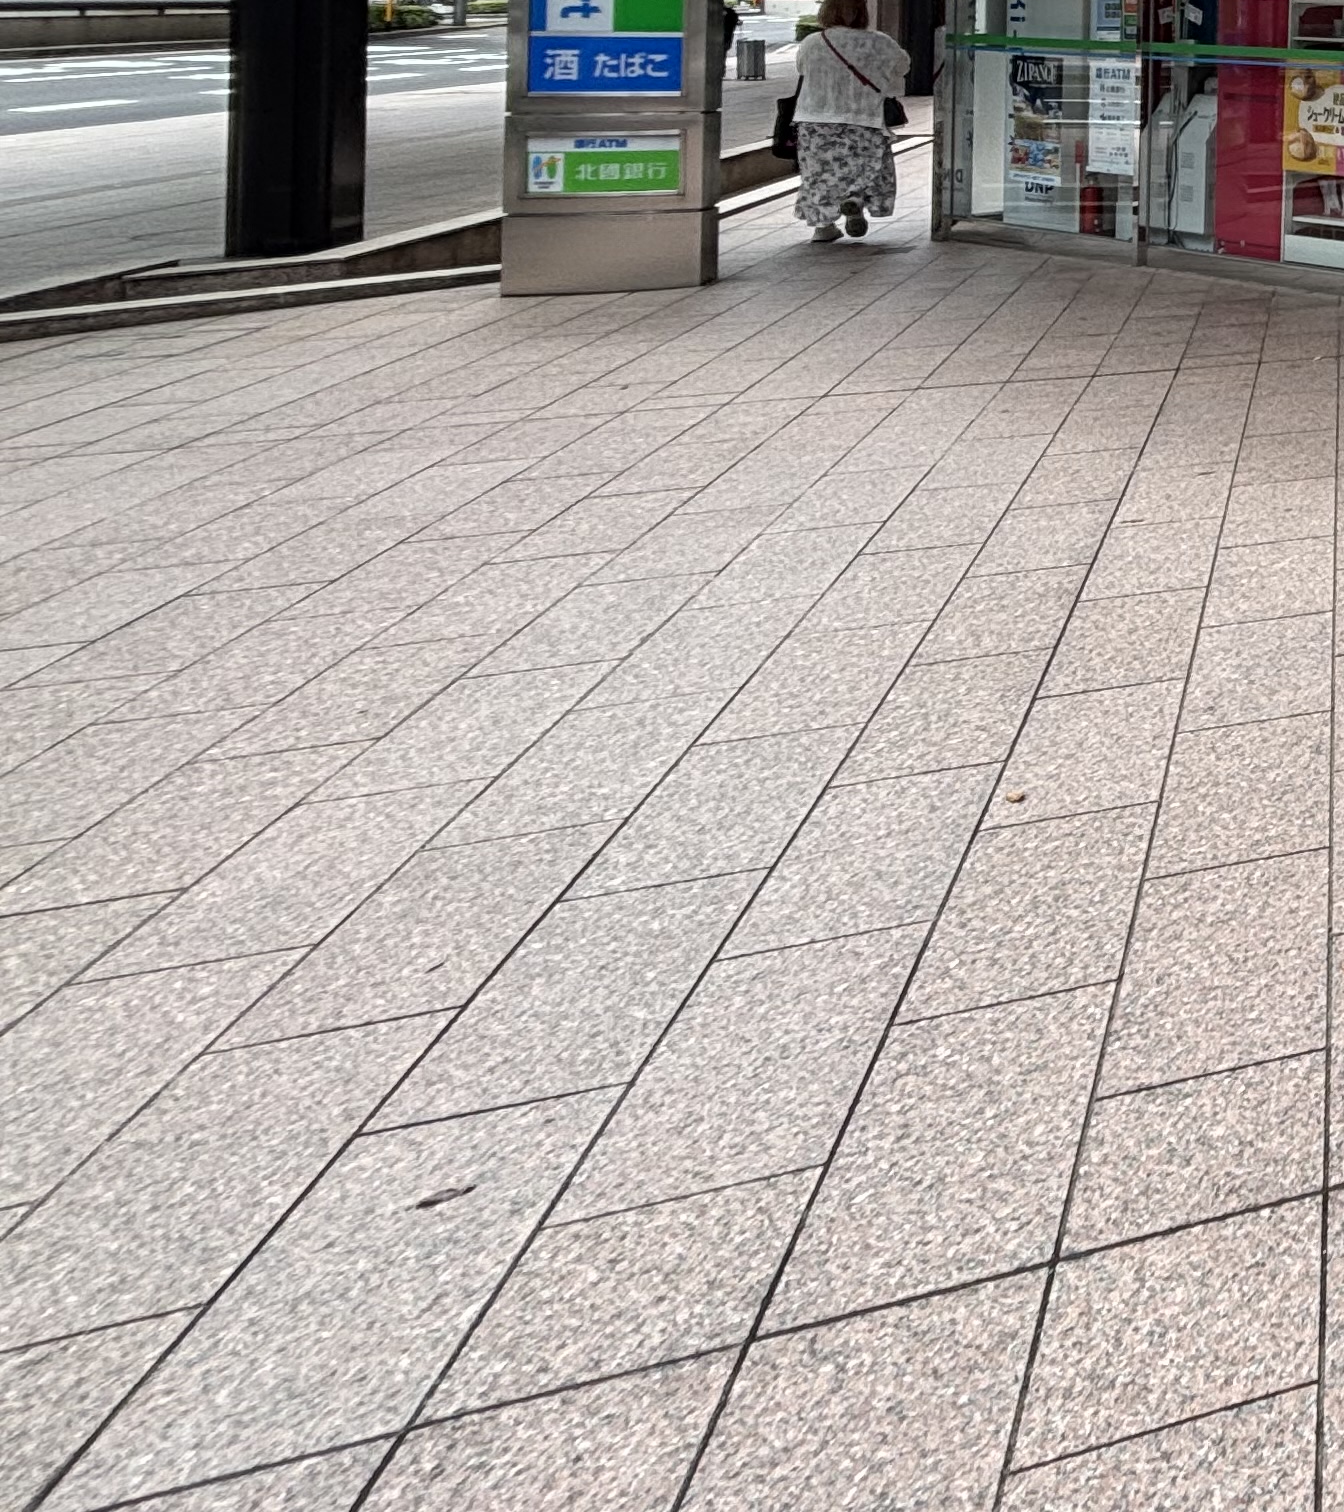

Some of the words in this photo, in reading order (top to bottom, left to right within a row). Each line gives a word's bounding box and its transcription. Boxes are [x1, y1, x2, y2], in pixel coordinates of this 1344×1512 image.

[543, 48, 581, 81] 酒
[593, 51, 670, 78] たばこ
[575, 161, 668, 181] 北國銀行
